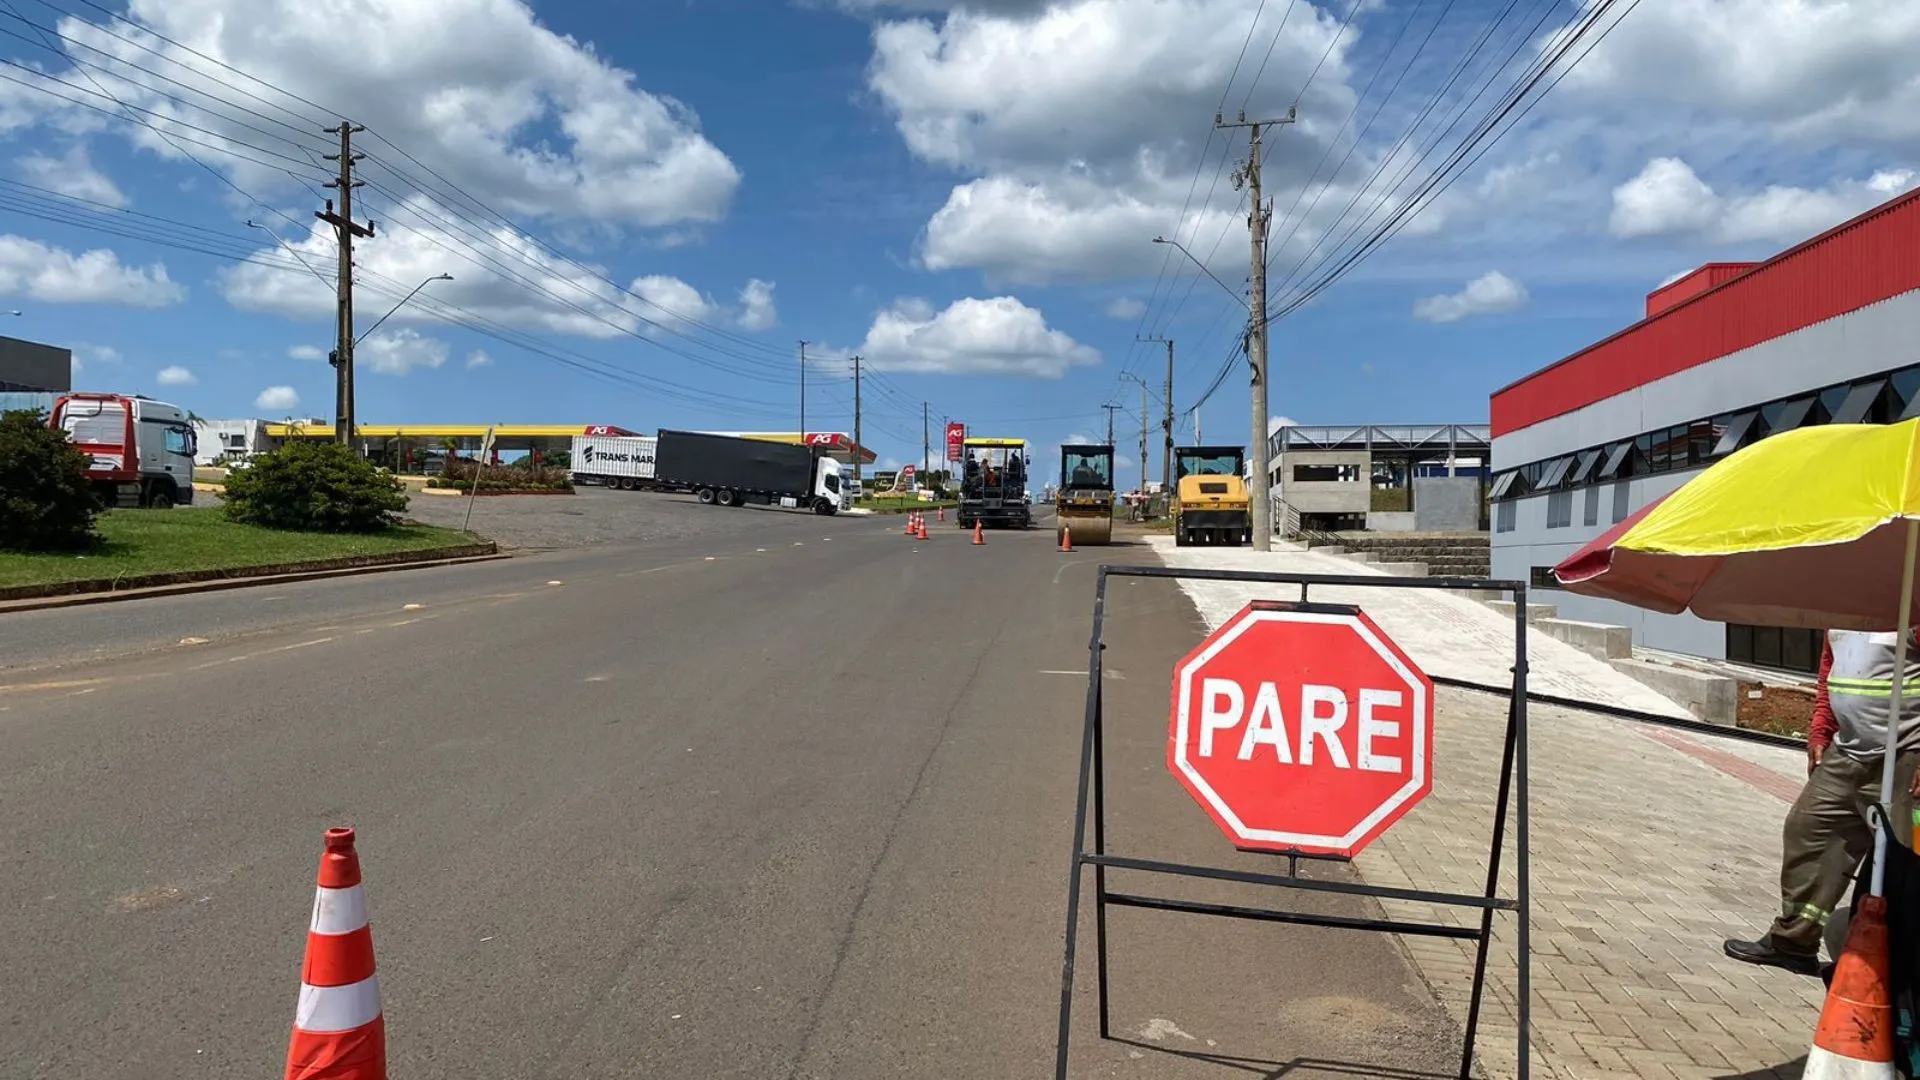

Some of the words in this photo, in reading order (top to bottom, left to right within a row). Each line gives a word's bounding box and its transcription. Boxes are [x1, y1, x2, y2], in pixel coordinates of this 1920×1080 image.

[591, 426, 608, 434] AG
[948, 429, 963, 437] AG
[812, 433, 832, 443] AG
[595, 452, 629, 462] TRANS
[631, 454, 655, 464] MAR
[1198, 677, 1403, 774] PARE
